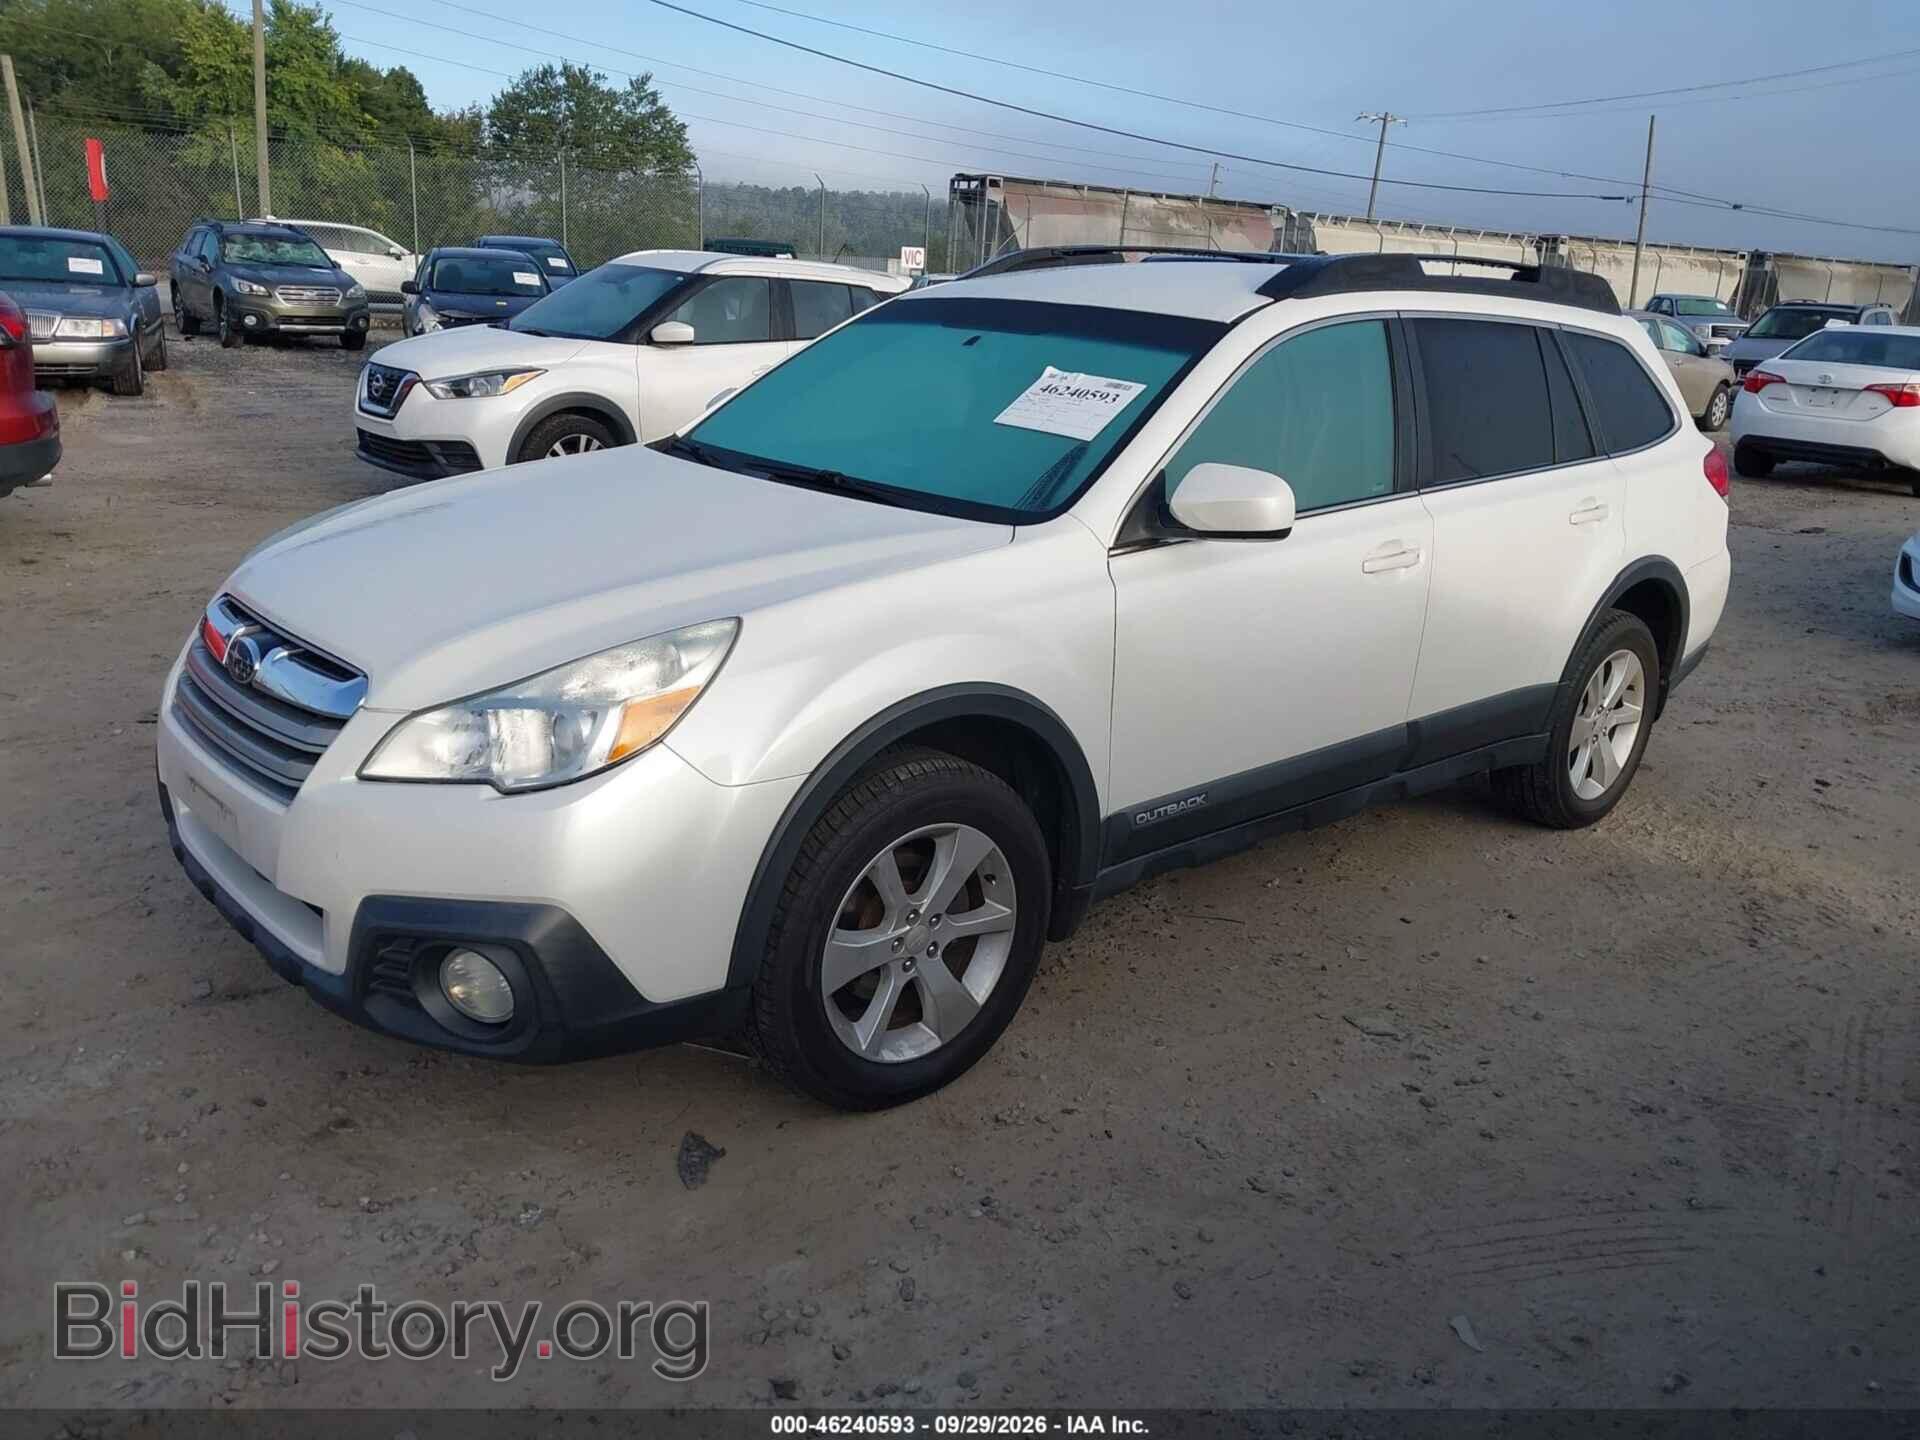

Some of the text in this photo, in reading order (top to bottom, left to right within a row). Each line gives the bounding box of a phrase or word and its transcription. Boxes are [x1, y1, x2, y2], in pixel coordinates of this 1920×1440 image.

[904, 249, 922, 266] VIC
[1039, 383, 1121, 404] 46240593
[1135, 793, 1208, 825] OUTBACK
